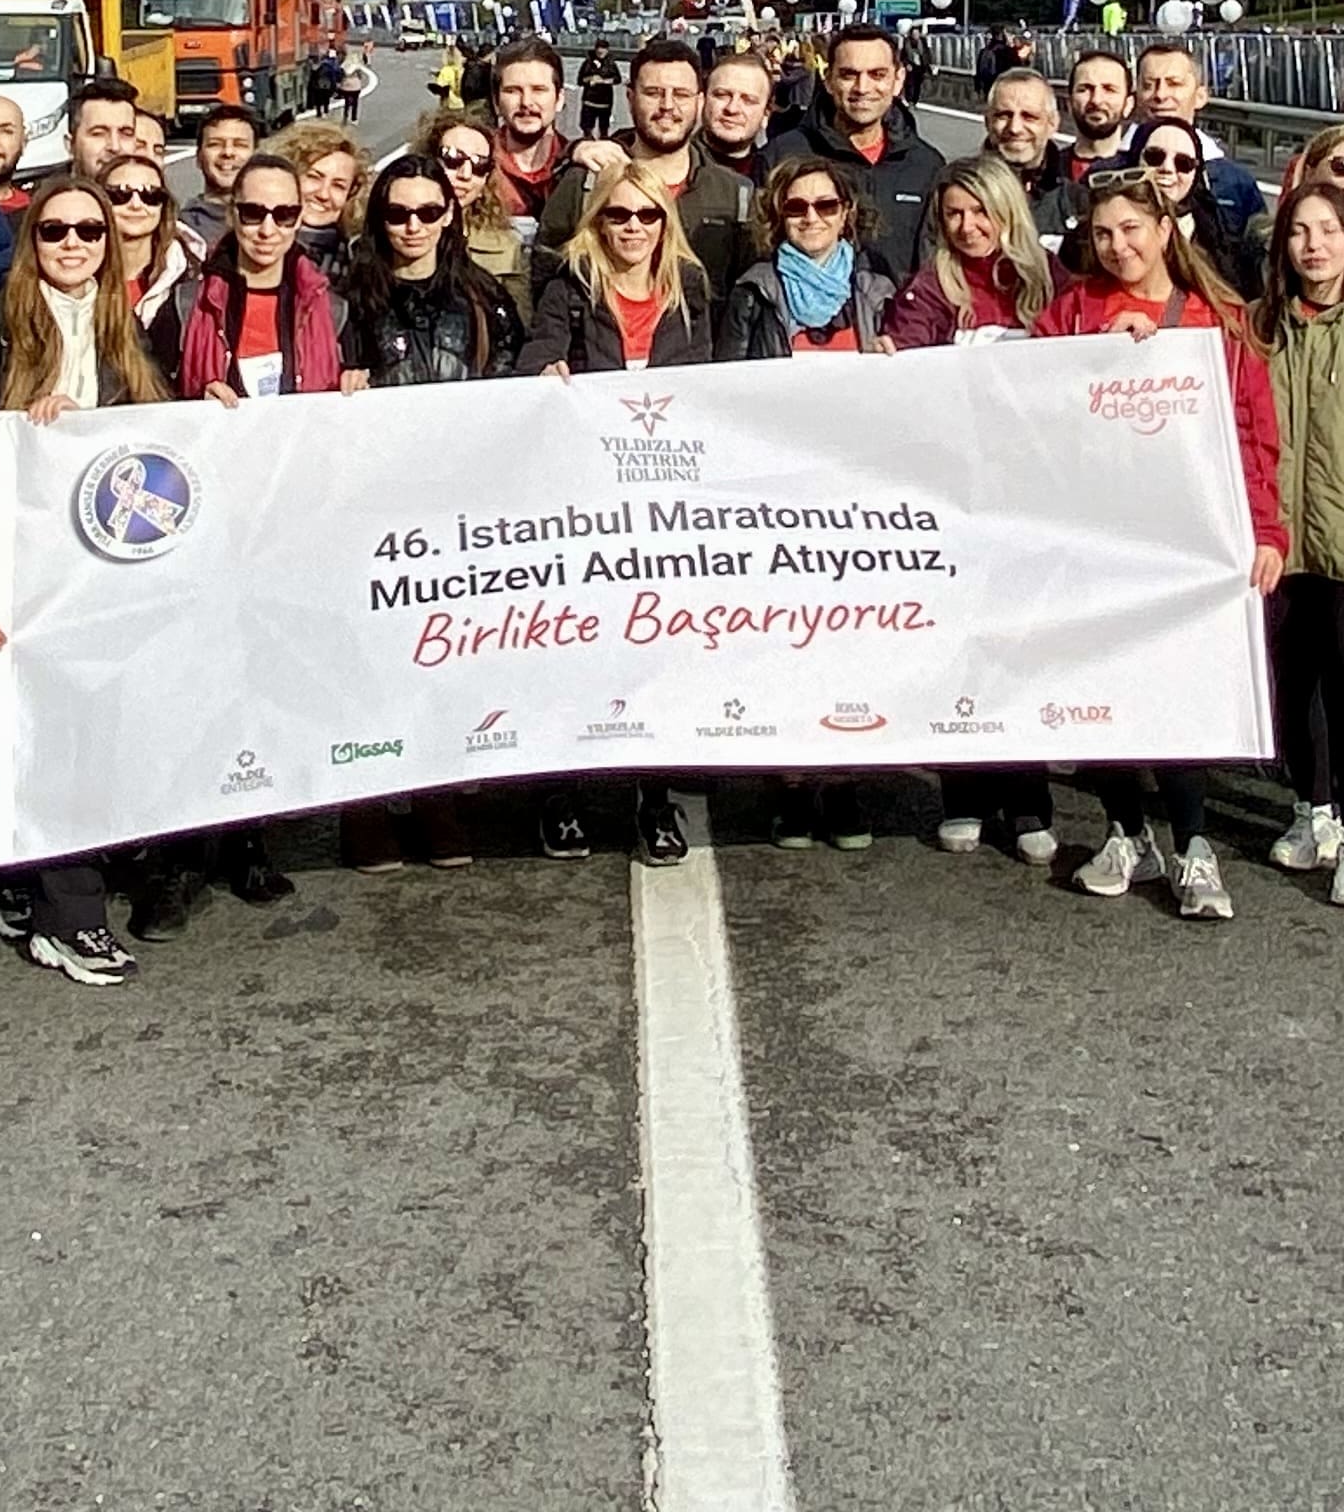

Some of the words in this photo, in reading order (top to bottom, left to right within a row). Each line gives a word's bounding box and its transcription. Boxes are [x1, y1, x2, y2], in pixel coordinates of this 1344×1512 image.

[1088, 376, 1205, 414] yaşama
[1100, 396, 1199, 423] değeriz
[599, 436, 706, 455] YILDIZLAR
[612, 452, 698, 467] YATIRIM
[373, 527, 441, 562] 46.
[457, 500, 633, 552] İstanbul
[647, 500, 940, 532] Maratonu'nda
[370, 553, 566, 611] Mucizevi
[582, 543, 753, 584] Adımlar
[768, 543, 957, 582] Atıyoruz,
[412, 599, 600, 668] Birlikte
[623, 590, 937, 650] Başarıyoruz.
